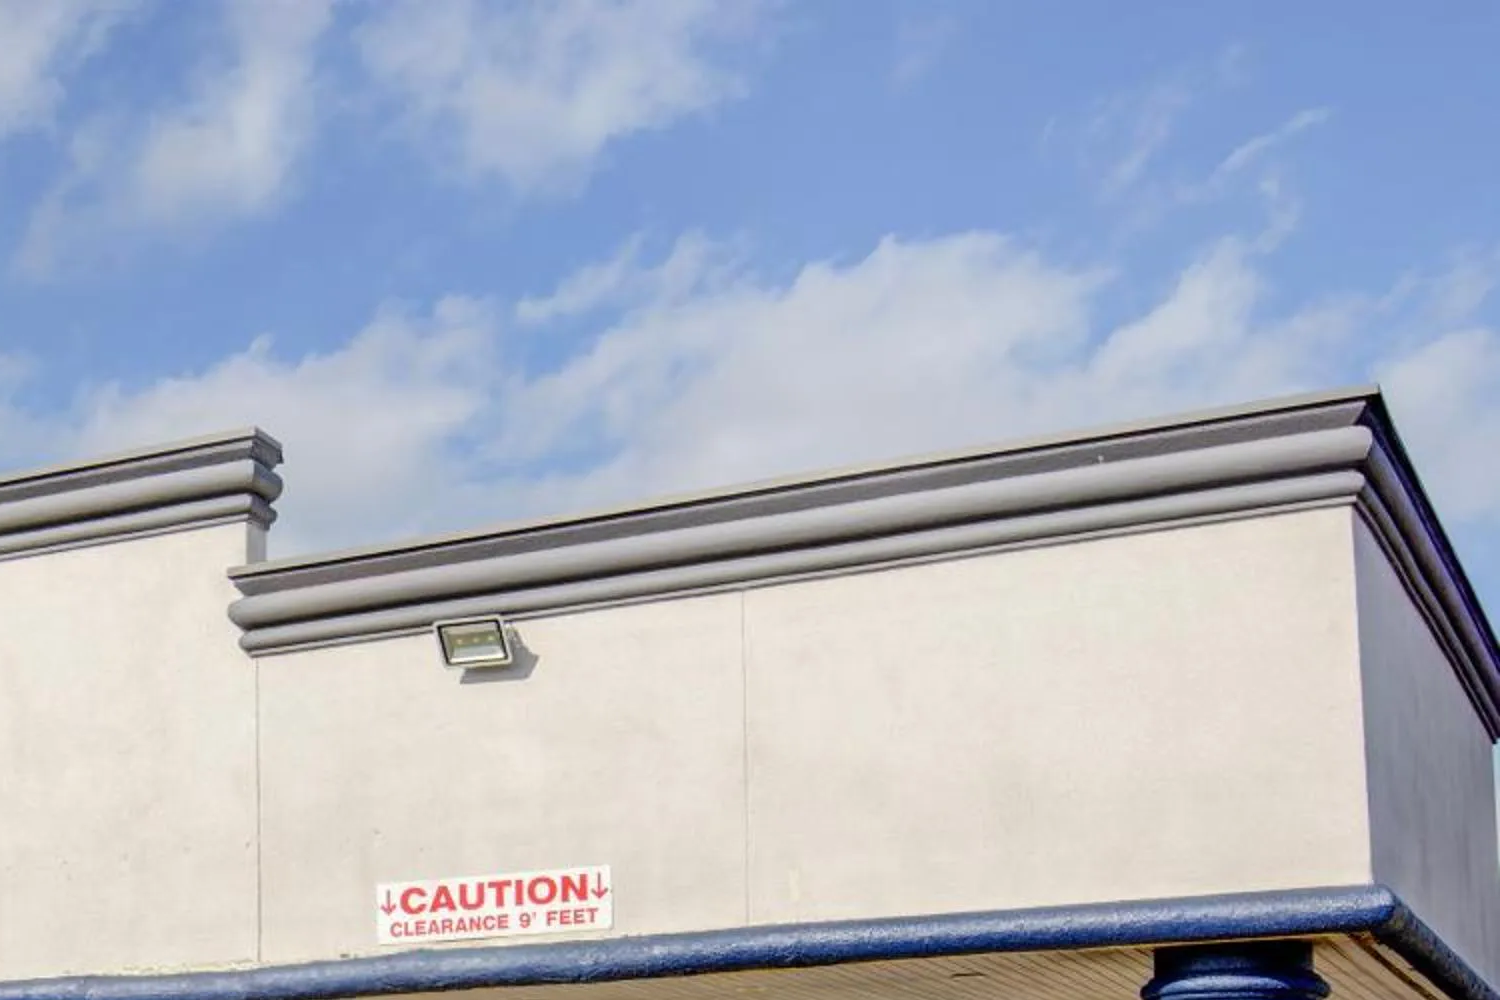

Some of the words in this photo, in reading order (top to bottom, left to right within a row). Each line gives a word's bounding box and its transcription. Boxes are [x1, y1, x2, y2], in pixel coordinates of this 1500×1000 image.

[400, 873, 588, 915] CAUTION
[390, 913, 509, 938] CLEARANCE
[519, 911, 537, 929] 9'
[546, 907, 599, 926] FEET
